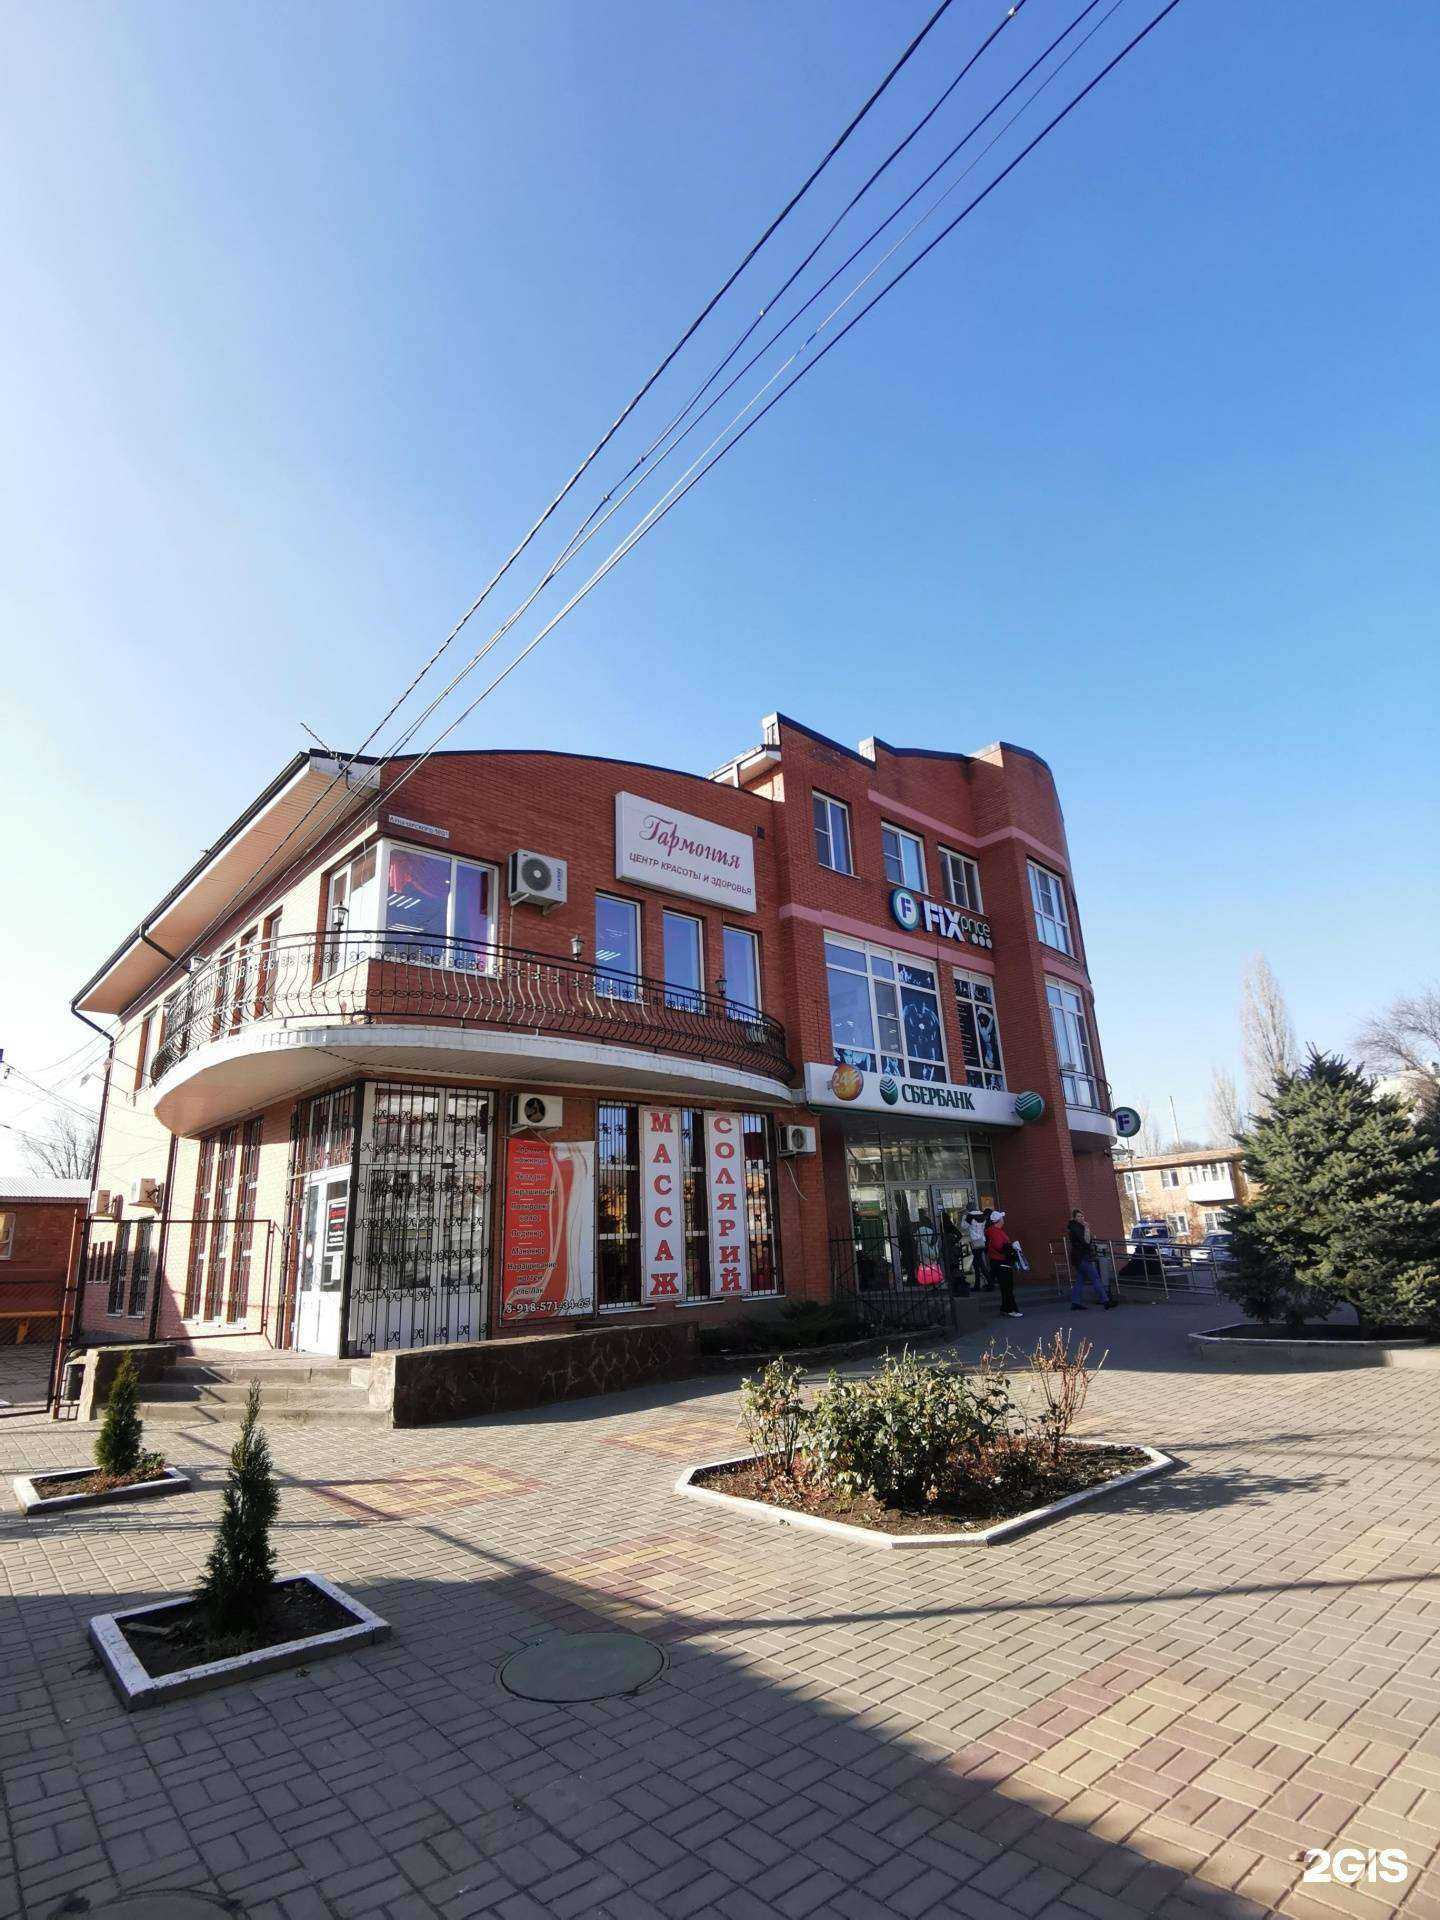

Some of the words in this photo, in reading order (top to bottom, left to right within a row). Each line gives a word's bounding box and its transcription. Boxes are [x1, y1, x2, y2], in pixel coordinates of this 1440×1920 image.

[639, 814, 742, 869] Гармония
[629, 852, 659, 869] ЦЕНТР
[661, 861, 701, 880] КРАСОТЫ
[703, 873, 709, 883] И
[711, 878, 752, 895] ЗДОРОВЬЯ
[960, 916, 991, 938] price
[902, 1084, 975, 1110] СБЕРБАНК
[1117, 1114, 1130, 1130] F
[650, 1113, 679, 1295] МАССАЖ
[714, 1117, 742, 1292] СОЛЯРИЙ
[512, 1247, 545, 1256] Маникюр
[506, 1298, 591, 1314] 8-918-571-34-65
